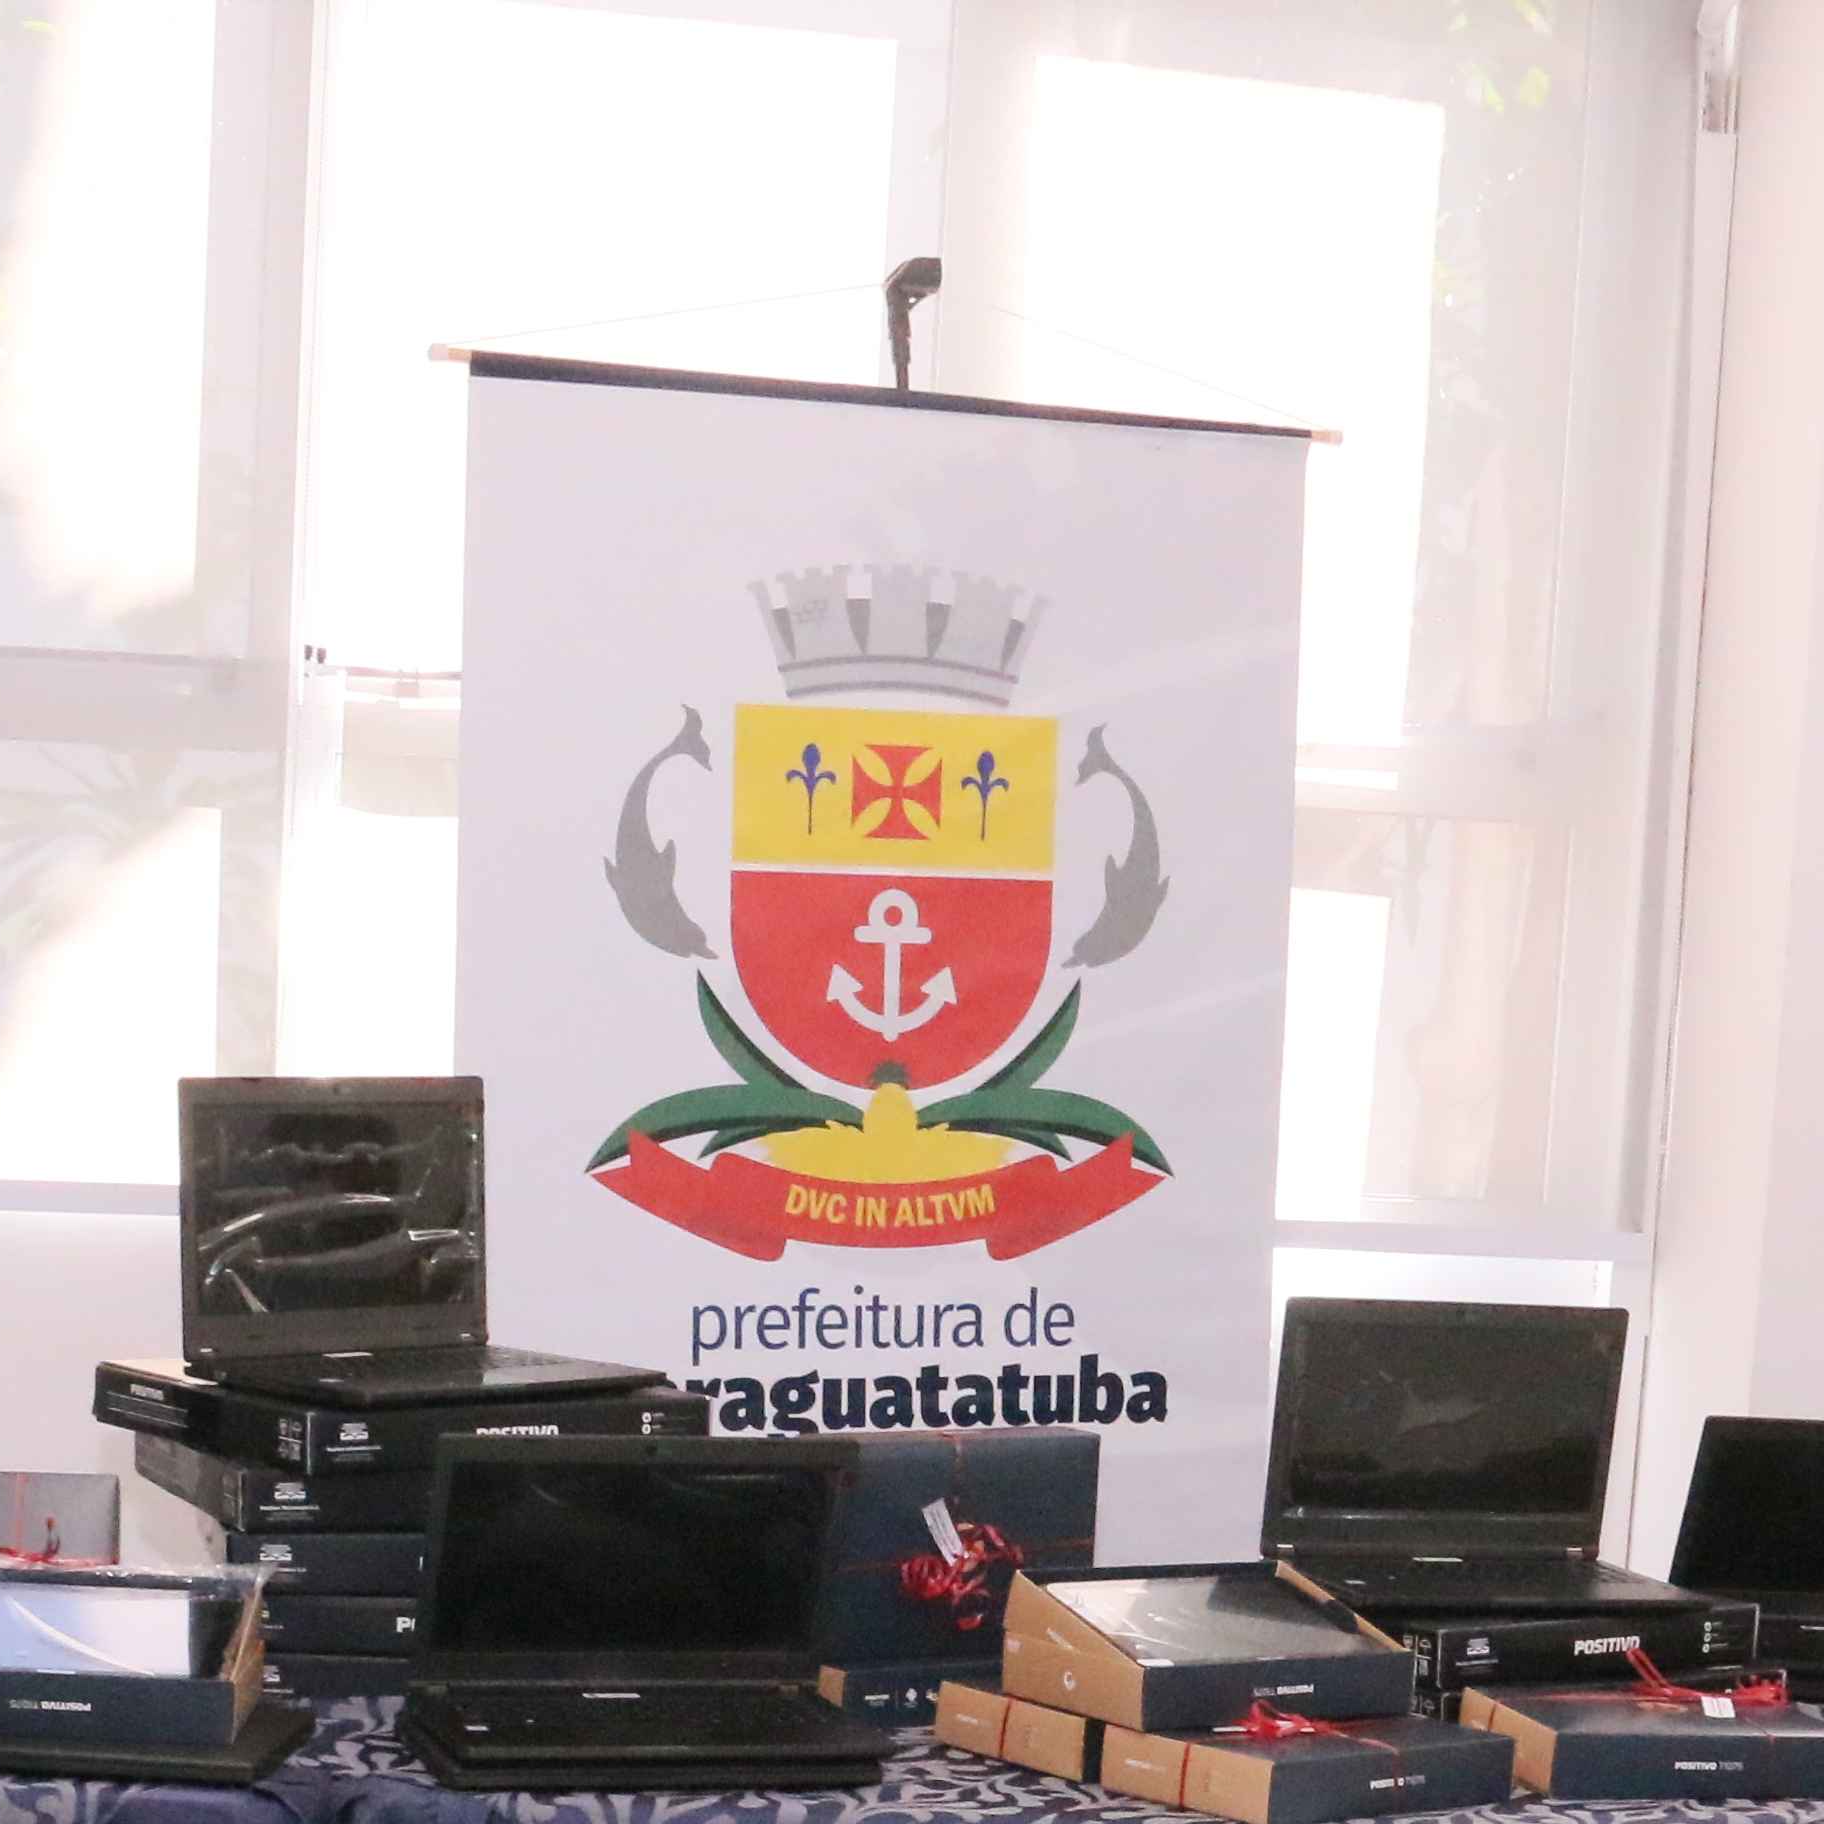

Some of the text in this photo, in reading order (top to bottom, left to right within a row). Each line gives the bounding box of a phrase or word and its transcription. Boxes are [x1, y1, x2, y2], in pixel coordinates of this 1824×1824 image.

[784, 1183, 996, 1228] DVC IN ALTVM
[691, 1284, 1074, 1366] prefeitura de
[1573, 1635, 1640, 1656] POSITIVO
